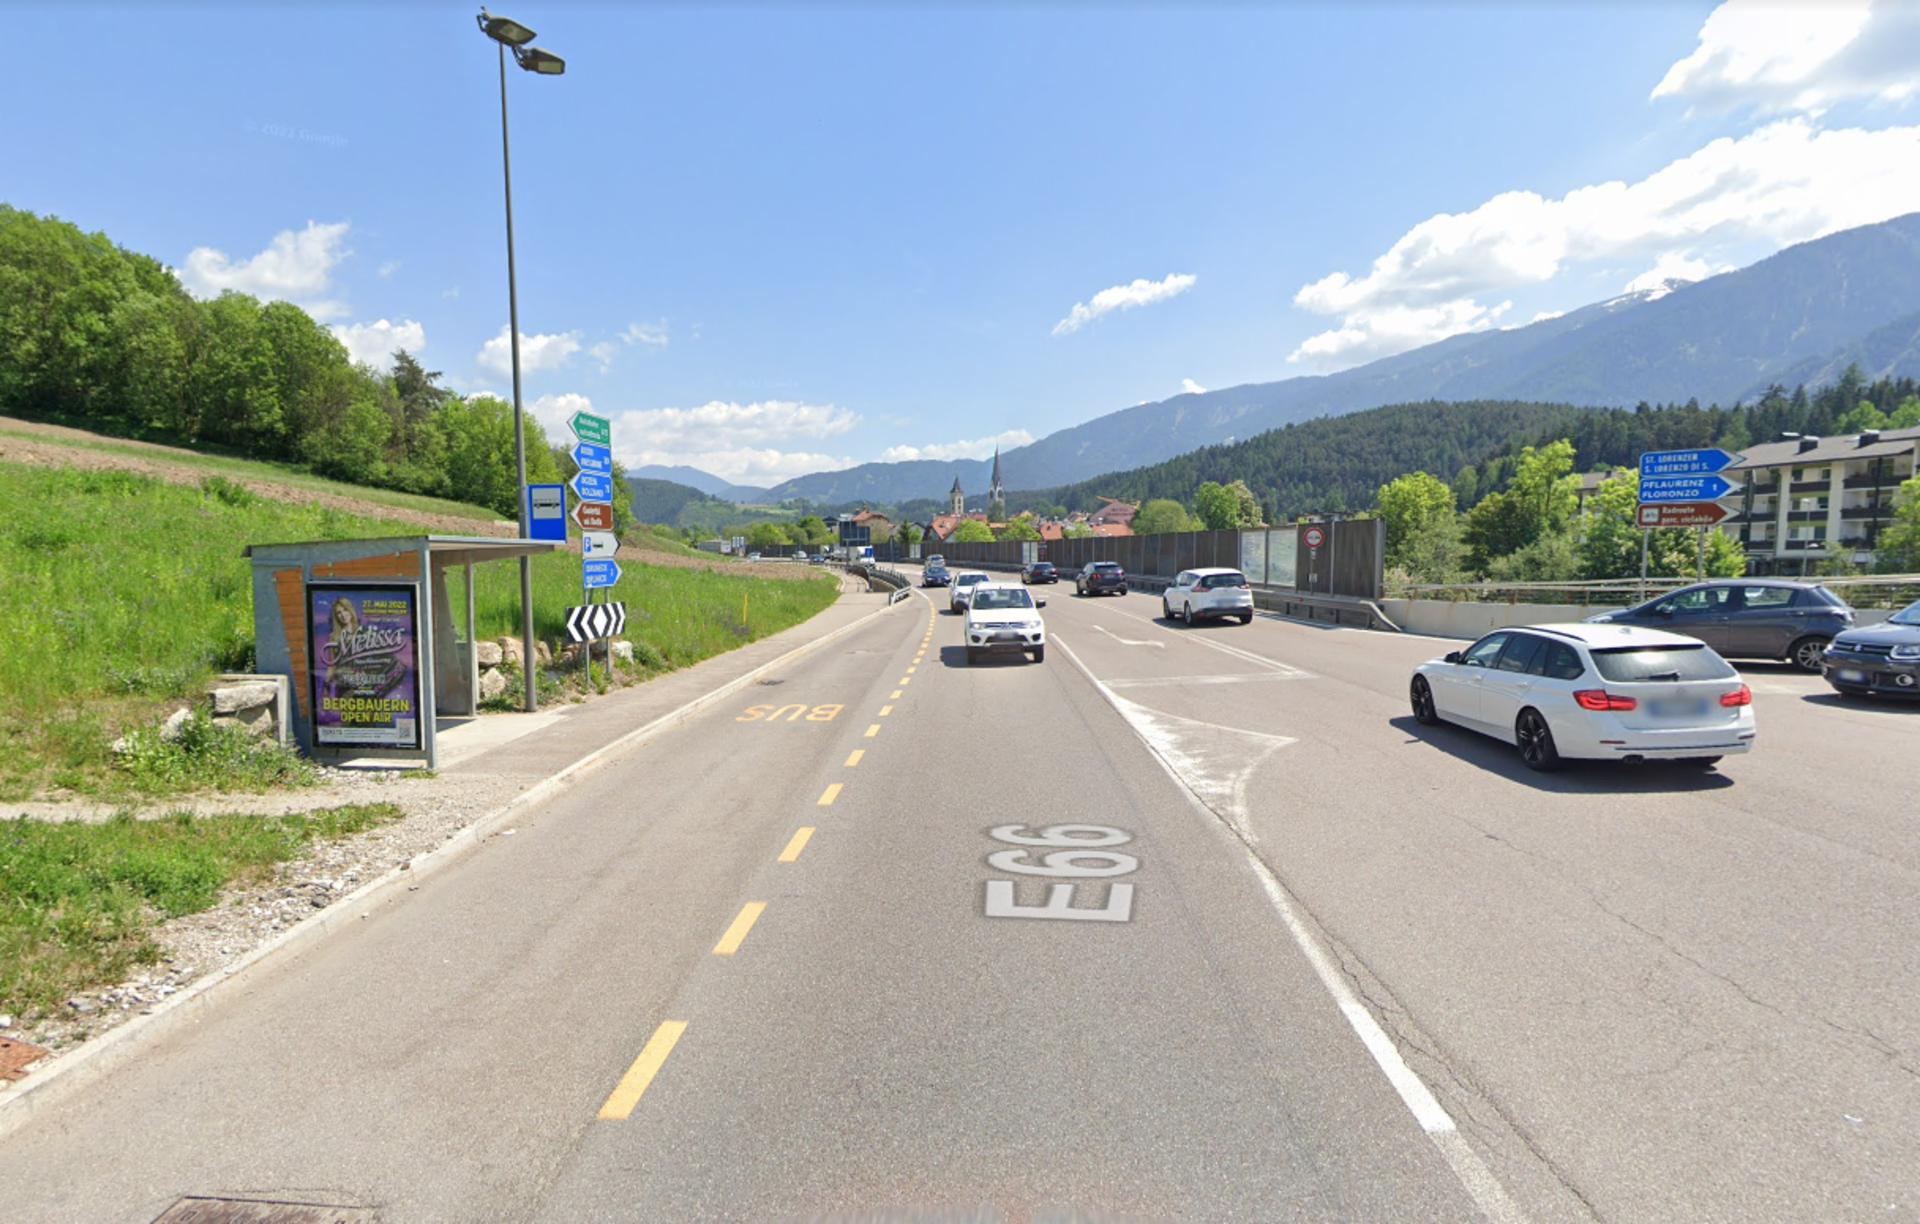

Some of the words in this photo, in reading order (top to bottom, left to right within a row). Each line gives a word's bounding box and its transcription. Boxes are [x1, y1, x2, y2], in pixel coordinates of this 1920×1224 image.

[1645, 456, 1656, 464] ST.
[1654, 463, 1689, 473] LORENZO
[1691, 463, 1700, 471] DI
[1642, 479, 1705, 489] PFLAURENZ
[1641, 490, 1699, 498] FLORONZO
[389, 600, 408, 609] 2022
[323, 697, 409, 712] BERGBAUERN
[341, 711, 370, 722] OPEN
[373, 712, 391, 723] AIR
[736, 704, 846, 721] BUS
